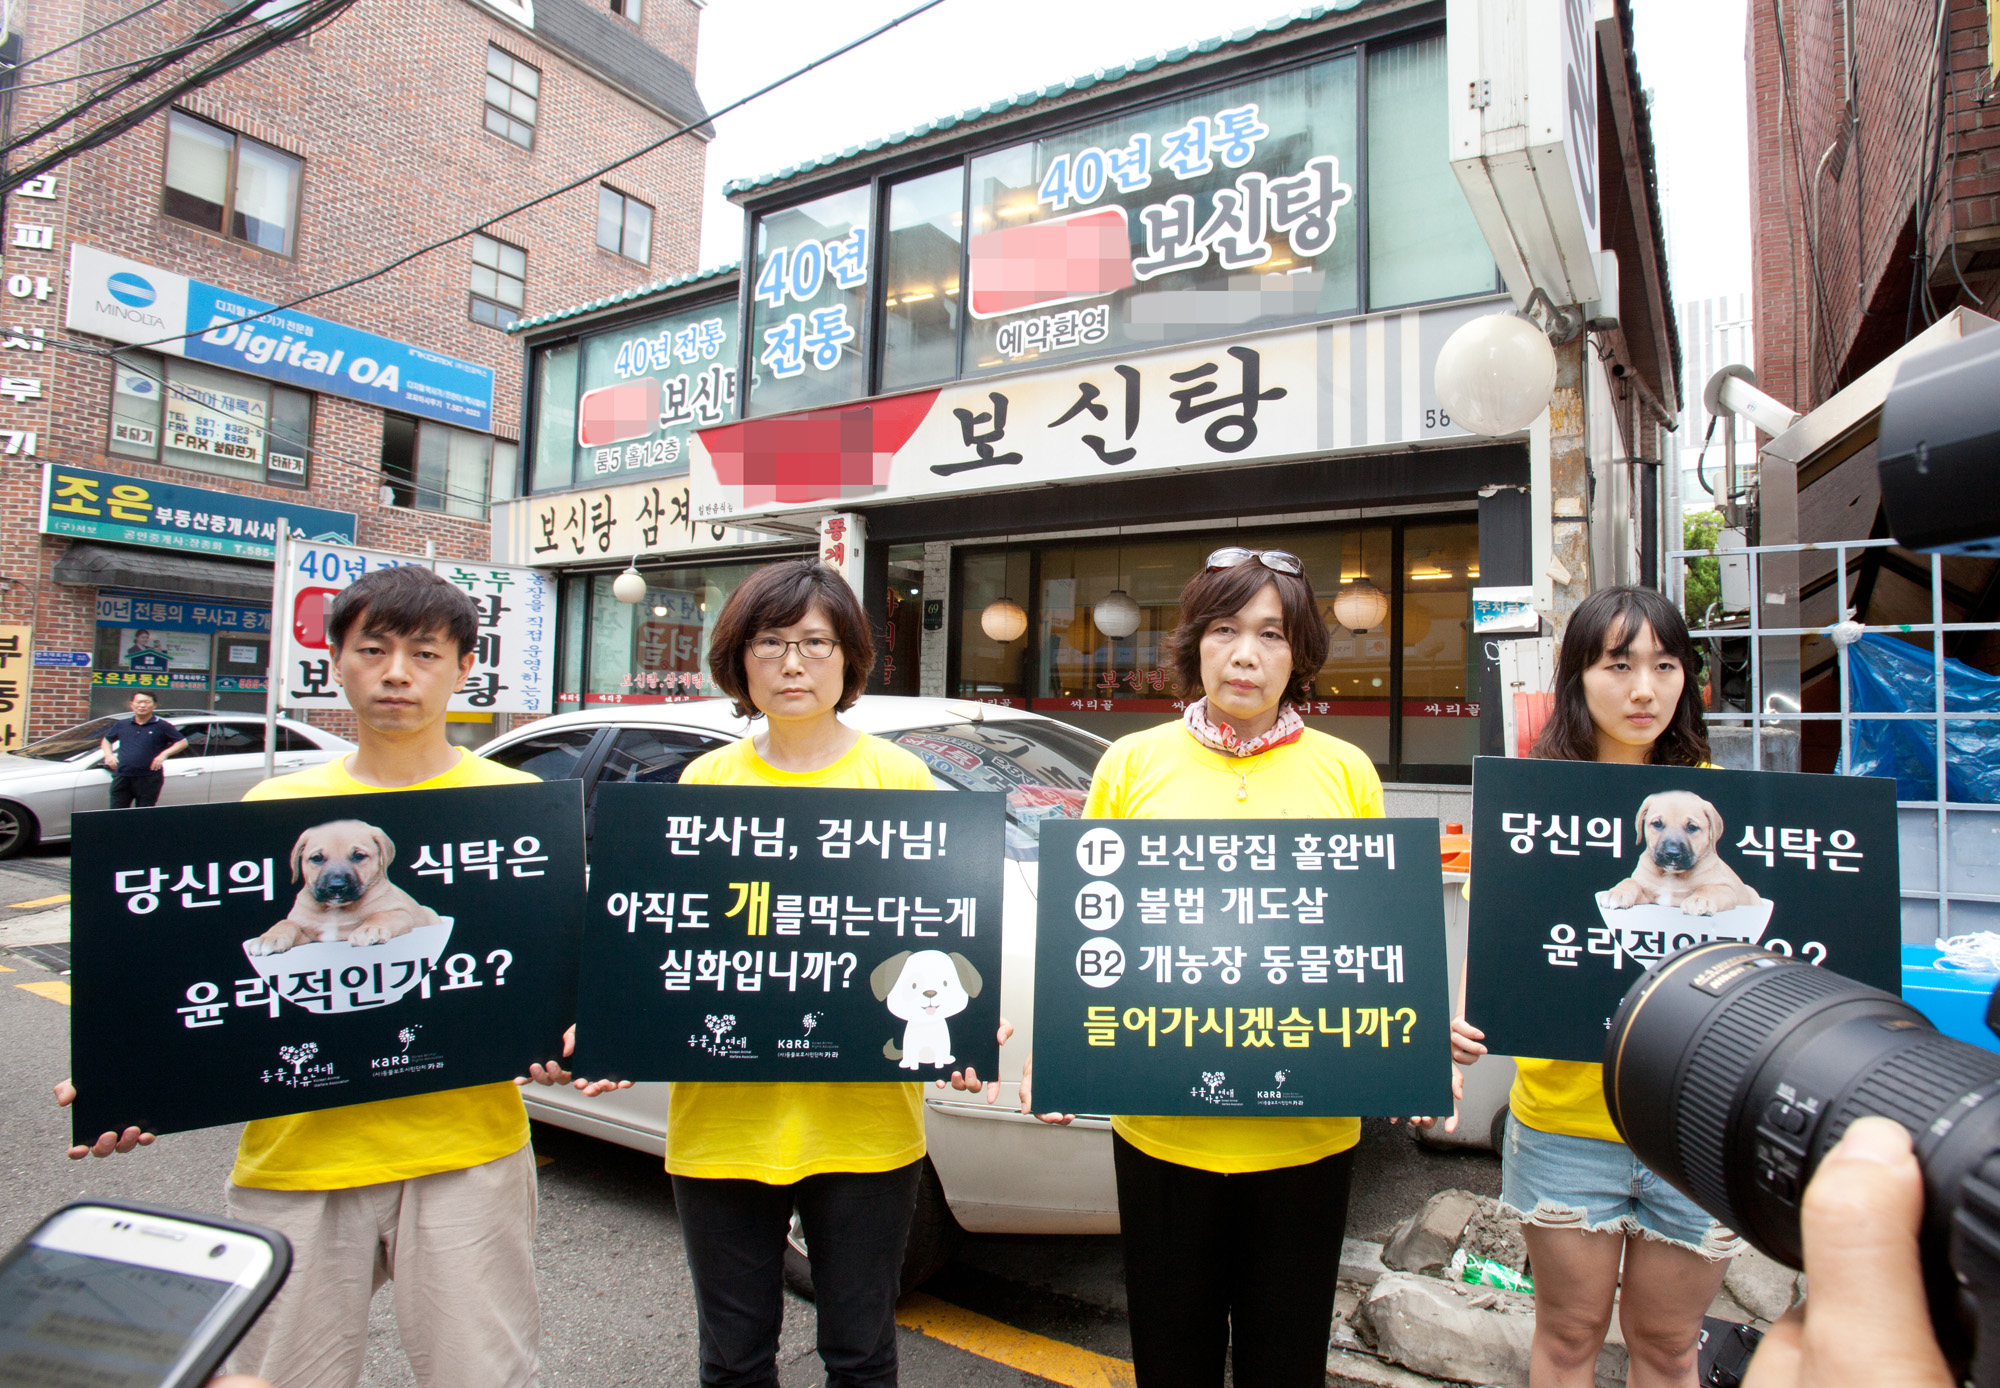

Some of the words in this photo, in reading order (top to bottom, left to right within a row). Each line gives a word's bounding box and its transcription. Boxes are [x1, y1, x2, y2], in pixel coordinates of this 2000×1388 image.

[1038, 133, 1151, 210] 40년
[1160, 104, 1269, 180] 전통
[1133, 157, 1352, 280] 보신탕
[756, 225, 869, 308] 40년
[95, 300, 166, 330] MINOLTA
[215, 299, 246, 318] 디지털
[286, 320, 314, 338] 전문점
[997, 306, 1109, 356] 예약환영
[201, 314, 345, 377] Digital
[348, 356, 400, 393] OA
[615, 331, 670, 377] 40년
[674, 318, 727, 363] 전통
[760, 304, 856, 379] 전통
[168, 411, 188, 423] TEL
[929, 346, 1288, 477] 보신탕
[116, 424, 152, 444] 복사기
[168, 421, 189, 433] FAX
[224, 433, 249, 445] 8326
[174, 433, 208, 451] FAX
[272, 455, 302, 472] 타자기
[595, 447, 622, 474] 룸5
[51, 475, 154, 523] 조은
[156, 505, 307, 542] 부동산중개사사소
[534, 493, 617, 555] 보신탕
[635, 487, 726, 549] 삼계
[299, 550, 366, 583] 40년
[449, 567, 515, 593] 녹두
[134, 602, 184, 624] 전통의
[191, 607, 238, 626] 무사고
[242, 611, 271, 630] 중개
[928, 603, 939, 614] 69
[92, 671, 170, 686] 조은부동산
[665, 815, 799, 862] 판사님,
[817, 819, 948, 860] 검사님!
[1082, 840, 1118, 866] 1F
[1137, 833, 1276, 872] 보신탕집
[1292, 833, 1396, 872] 홀완비
[1502, 811, 1622, 858] 당신의
[1736, 825, 1864, 873] 식탁은
[114, 857, 275, 915] 당신의
[410, 835, 549, 885] 식탁은
[607, 891, 711, 933] 아직도
[1080, 893, 1117, 920] B1
[1136, 887, 1206, 925] 불법
[1220, 887, 1329, 925] 개도살
[659, 949, 858, 992] 실화입니까?
[1080, 949, 1122, 977] B2
[1138, 945, 1248, 985] 개농장
[1260, 944, 1404, 985] 동물학대
[176, 949, 514, 1029] 윤리적인가요?
[687, 1034, 710, 1048] 동물
[1083, 1006, 1417, 1048] 들어가시겠습니까?
[427, 1061, 445, 1070] 카라
[707, 1044, 729, 1056] 자유
[260, 1067, 288, 1083] 동물
[286, 1075, 312, 1089] 자유
